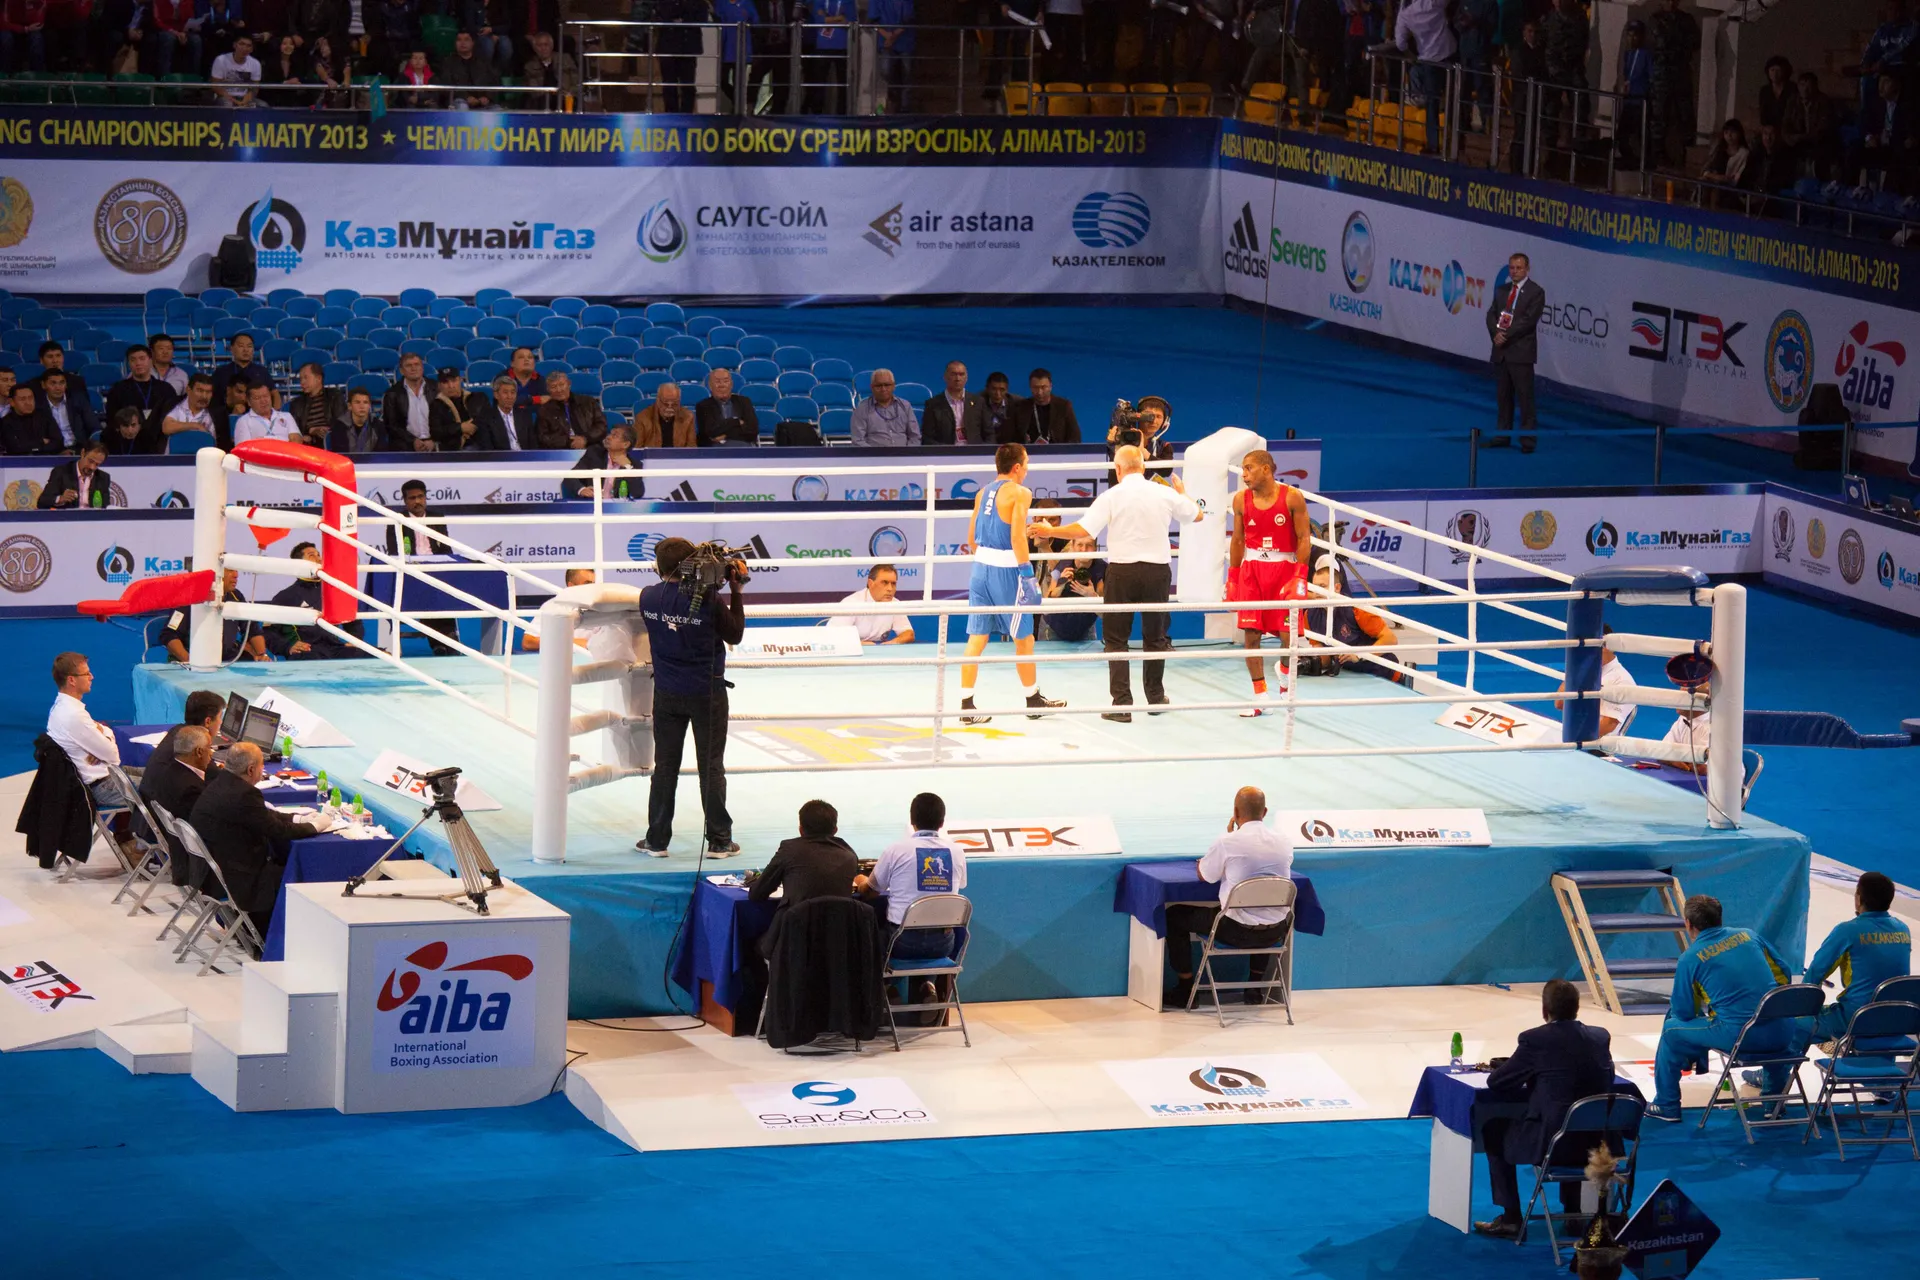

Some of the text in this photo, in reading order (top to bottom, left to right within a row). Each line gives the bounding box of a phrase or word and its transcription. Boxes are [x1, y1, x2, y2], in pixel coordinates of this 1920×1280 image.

[0, 119, 368, 149] NG CHAMPIONSHIPS, ALMATY 2013
[407, 126, 555, 153] ЧЕМПИОНАТ
[560, 127, 625, 153] МИРА
[687, 128, 720, 153] ПО
[724, 128, 796, 154] БОКСУ
[800, 128, 871, 156] СРЕДИ
[876, 128, 997, 154] ВЗРОСЛЫХ,
[1000, 128, 1146, 154] АЛМАТЫ-2013
[1220, 132, 1450, 202] AIBA WORLD BOXING CHAMPIONSHIPS, ALMATY 2013
[111, 206, 170, 245] 80
[696, 201, 828, 228] САУТС-ОЙЛ
[909, 210, 1034, 232] air astana
[916, 240, 937, 249] from
[938, 240, 953, 249] the
[977, 240, 987, 249] of
[987, 240, 1021, 250] eurasia
[1467, 182, 1514, 216] БОКСТАН
[1515, 191, 1569, 227] ЕРЕСЕКТЕР
[1569, 205, 1661, 245] АРАСЫНДАҒЫ
[1695, 225, 1730, 258] ӘЛЕМ
[1731, 231, 1816, 277] ЧЕМПИОНАТЫ,
[1817, 248, 1900, 291] АЛМАТЫ-2013
[385, 252, 436, 260] COMPANY
[1271, 227, 1327, 273] Sevens
[1389, 257, 1485, 313] KAZSPORT
[1842, 356, 1895, 410] aiba
[504, 490, 522, 502] air
[505, 544, 576, 557] air astana
[1359, 531, 1403, 553] aiba
[3, 551, 41, 576] 80
[643, 610, 658, 621] Host
[1696, 931, 1752, 963] KAZAKHSTAN
[400, 979, 511, 1035] aiba
[394, 1040, 467, 1054] International
[390, 1053, 498, 1068] Boxing Association
[758, 1108, 928, 1125] Sat&Co
[1628, 1232, 1704, 1250] Kazakhstan
